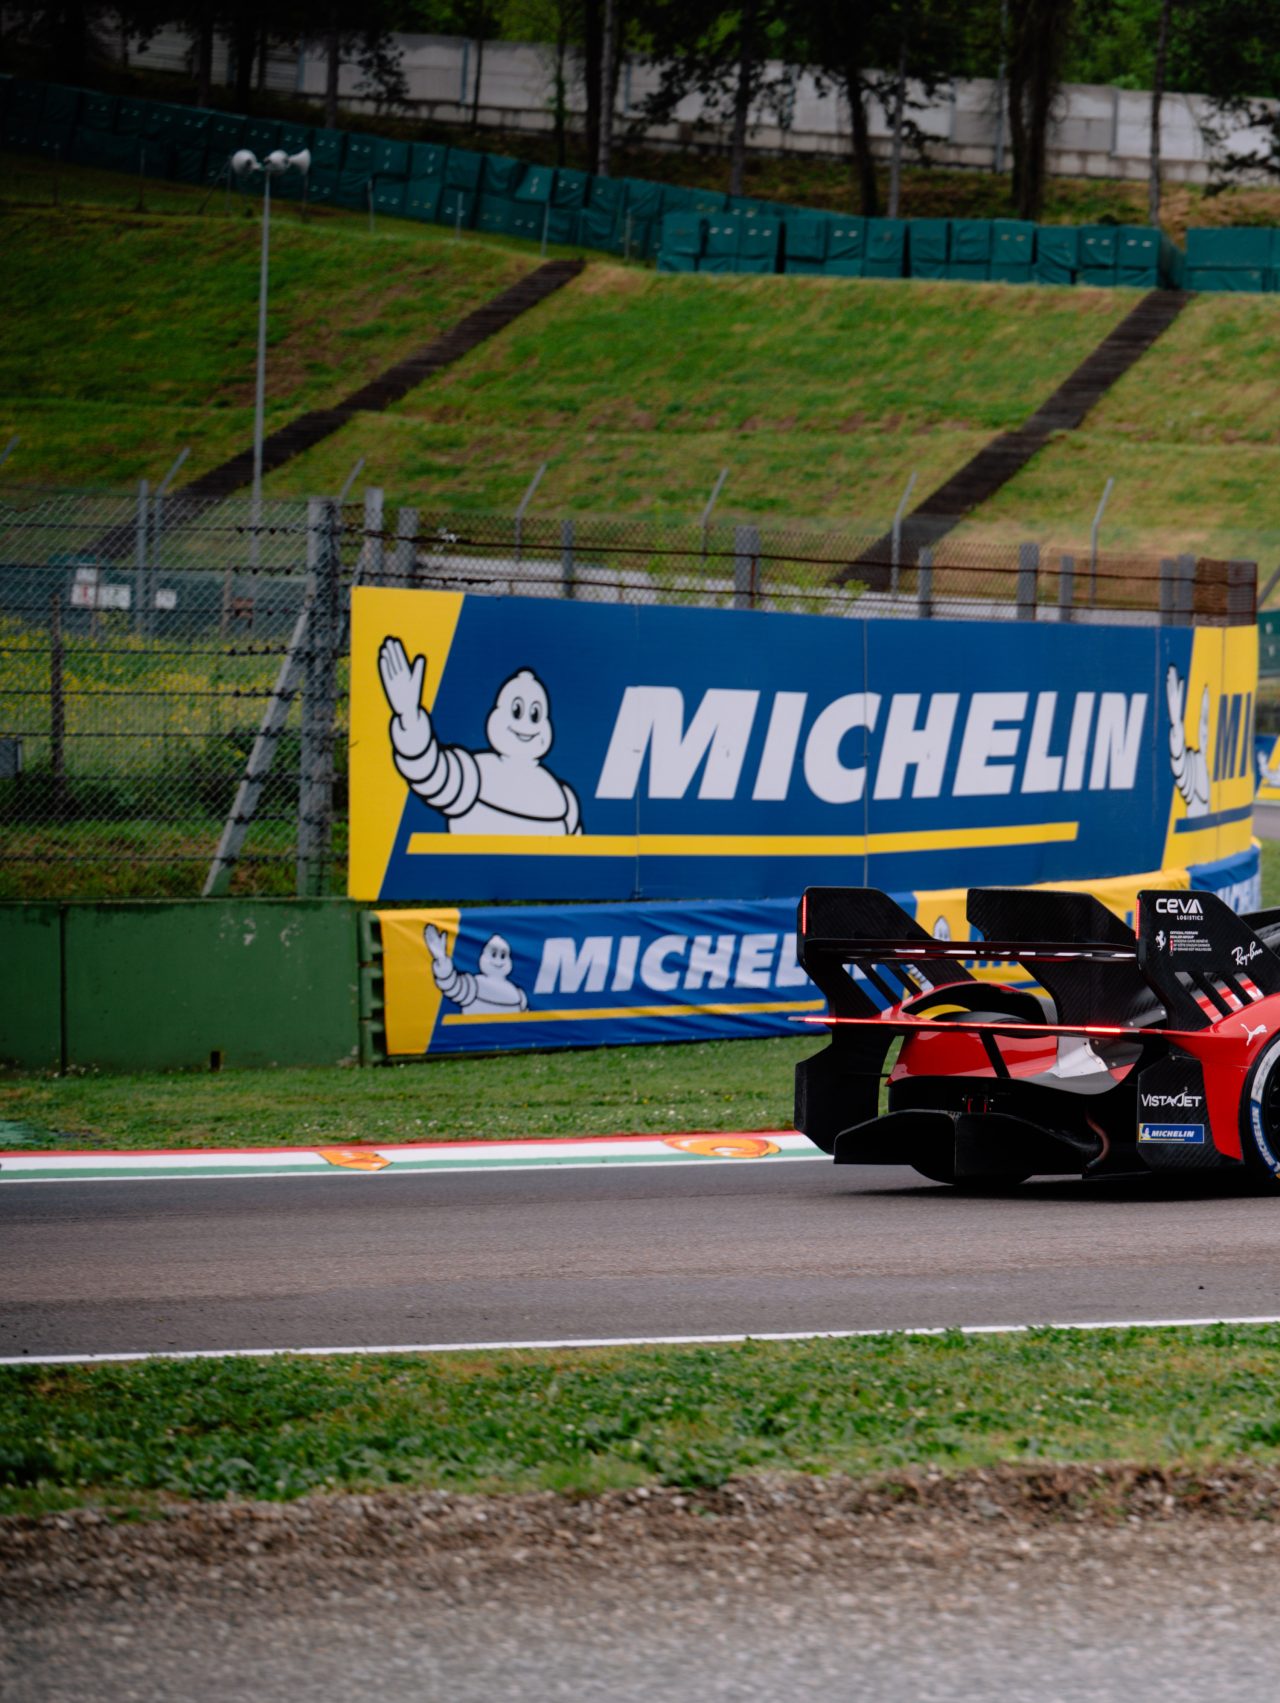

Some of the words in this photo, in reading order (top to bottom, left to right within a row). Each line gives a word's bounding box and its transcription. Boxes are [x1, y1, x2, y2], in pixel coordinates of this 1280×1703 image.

[594, 685, 1149, 803] MICHELIN
[533, 934, 815, 994] MICHEL
[1231, 941, 1264, 966] Ray-Ban
[1151, 1130, 1195, 1138] MICHELIN
